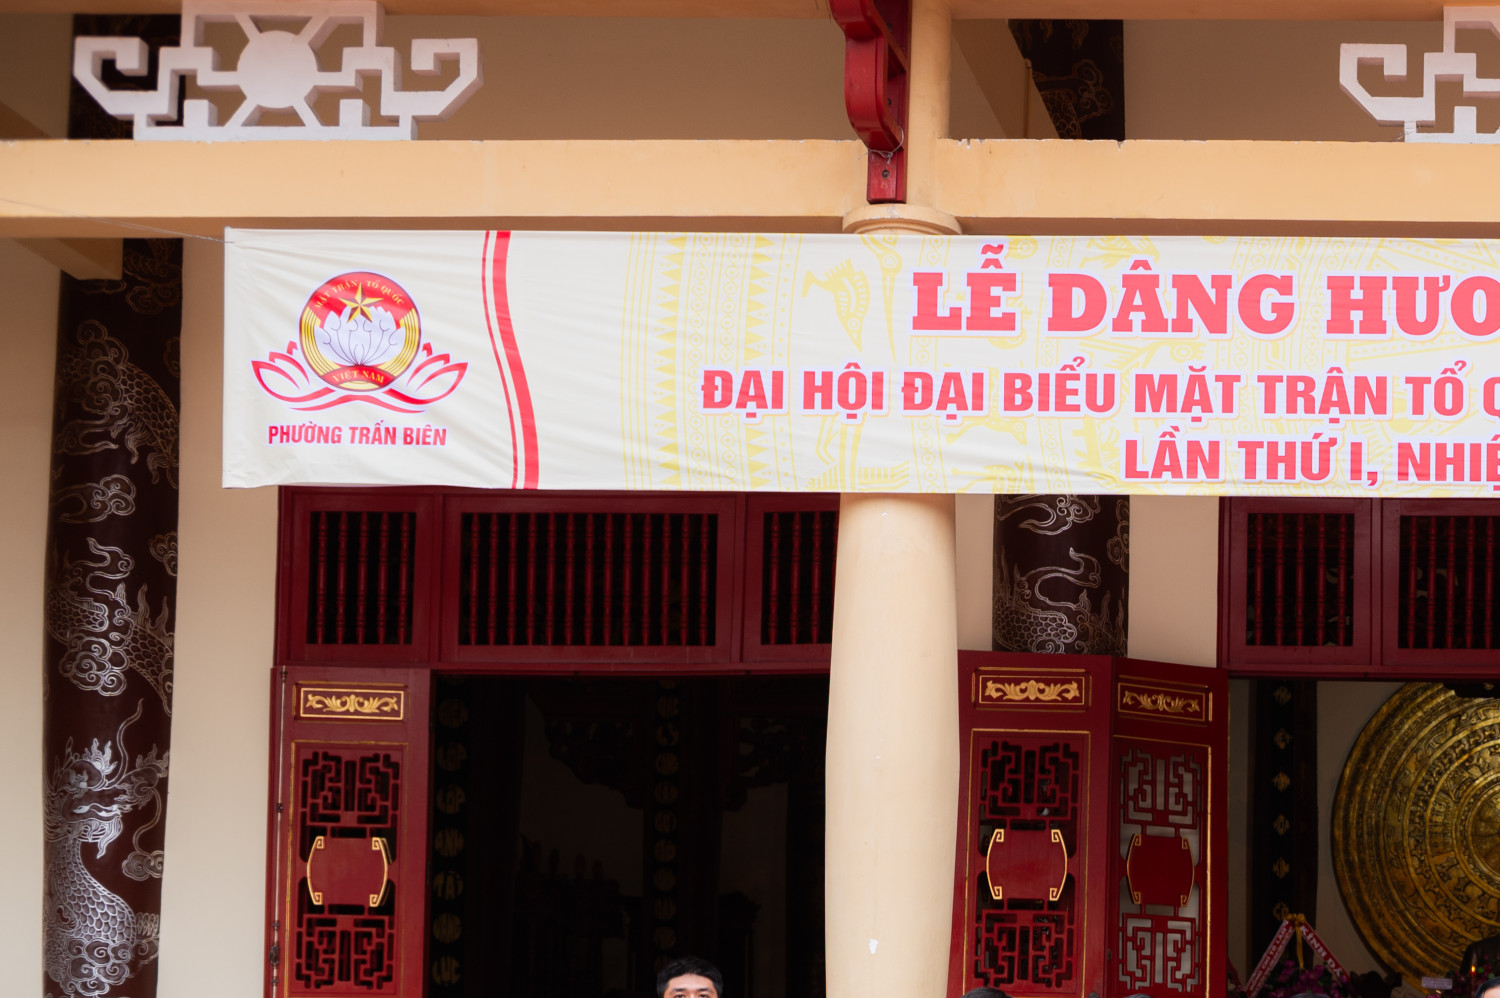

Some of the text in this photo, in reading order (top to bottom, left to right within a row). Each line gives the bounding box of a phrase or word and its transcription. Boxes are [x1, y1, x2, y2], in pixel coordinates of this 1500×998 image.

[912, 243, 1017, 332] LỄ
[1047, 259, 1295, 335] DÂNG
[333, 369, 384, 384] VIỆT NAM
[700, 369, 784, 419] ĐẠI
[802, 361, 884, 420] HỘI
[901, 371, 984, 421] ĐẠI
[1003, 355, 1116, 413] BIỂU
[1134, 365, 1242, 423] MẶT
[1256, 366, 1388, 424] TRẬN
[1404, 359, 1467, 417] TỔ
[268, 419, 447, 446] PHƯỜNG TRẤN BIÊN
[1124, 423, 1220, 480] LẦN
[1237, 432, 1338, 481] THỨ
[1349, 441, 1378, 487] I,
